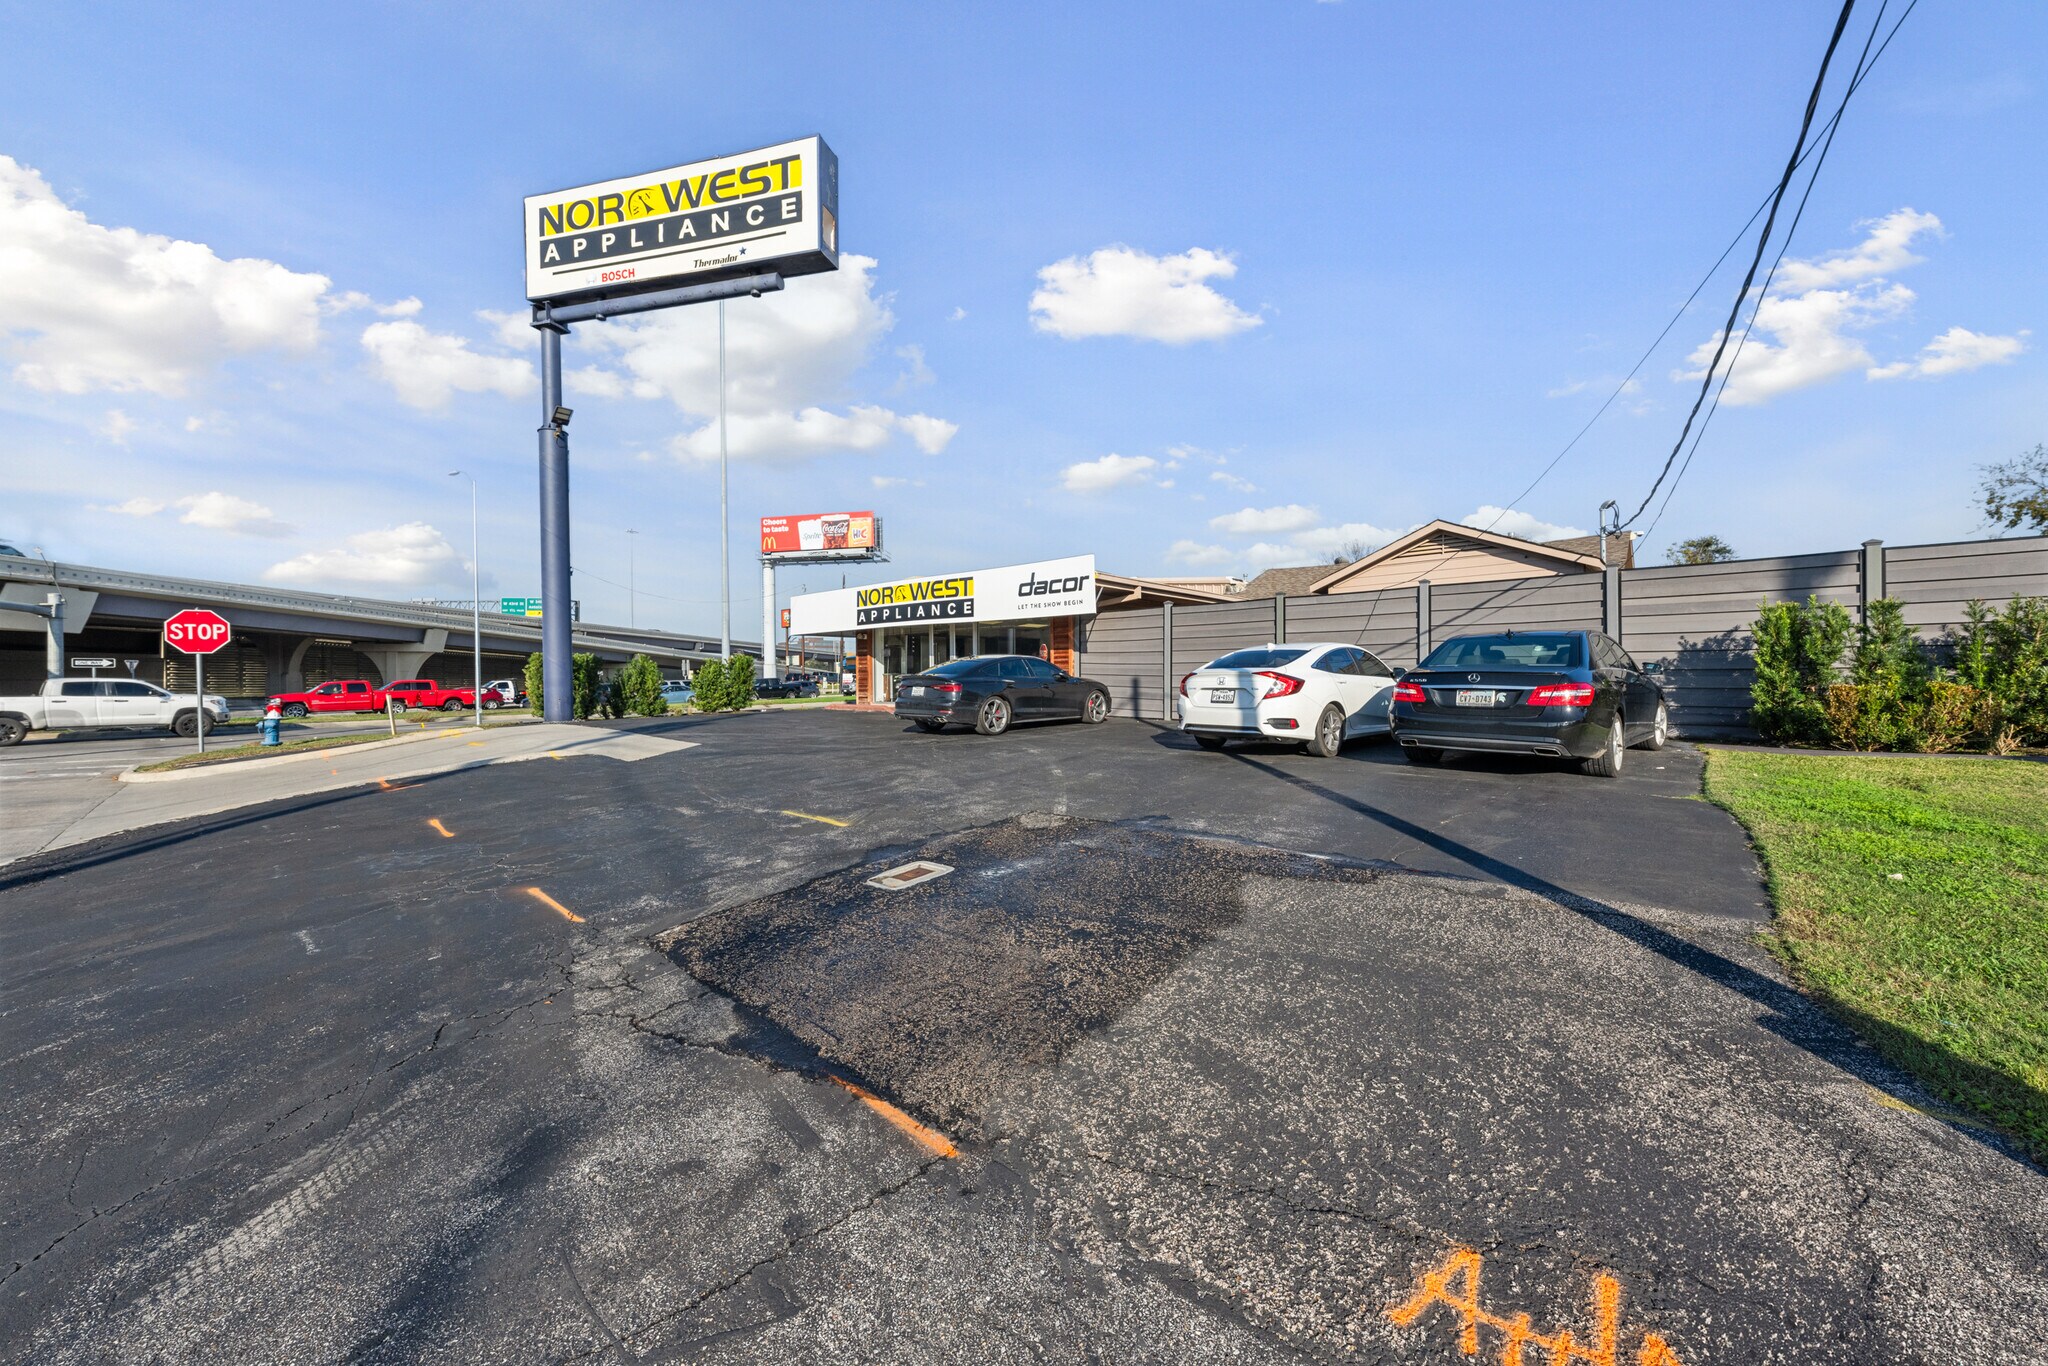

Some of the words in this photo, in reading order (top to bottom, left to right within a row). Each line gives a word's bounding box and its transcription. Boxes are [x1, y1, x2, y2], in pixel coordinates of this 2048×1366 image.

[544, 196, 798, 263] APPLIANCE
[693, 253, 738, 269] Thermador
[601, 268, 635, 283] BOSCH
[802, 532, 822, 540] Sprite
[1018, 572, 1090, 597] dacor
[1064, 599, 1084, 607] BEGIN
[859, 601, 972, 623] APPLIANCE
[169, 623, 226, 640] STOP
